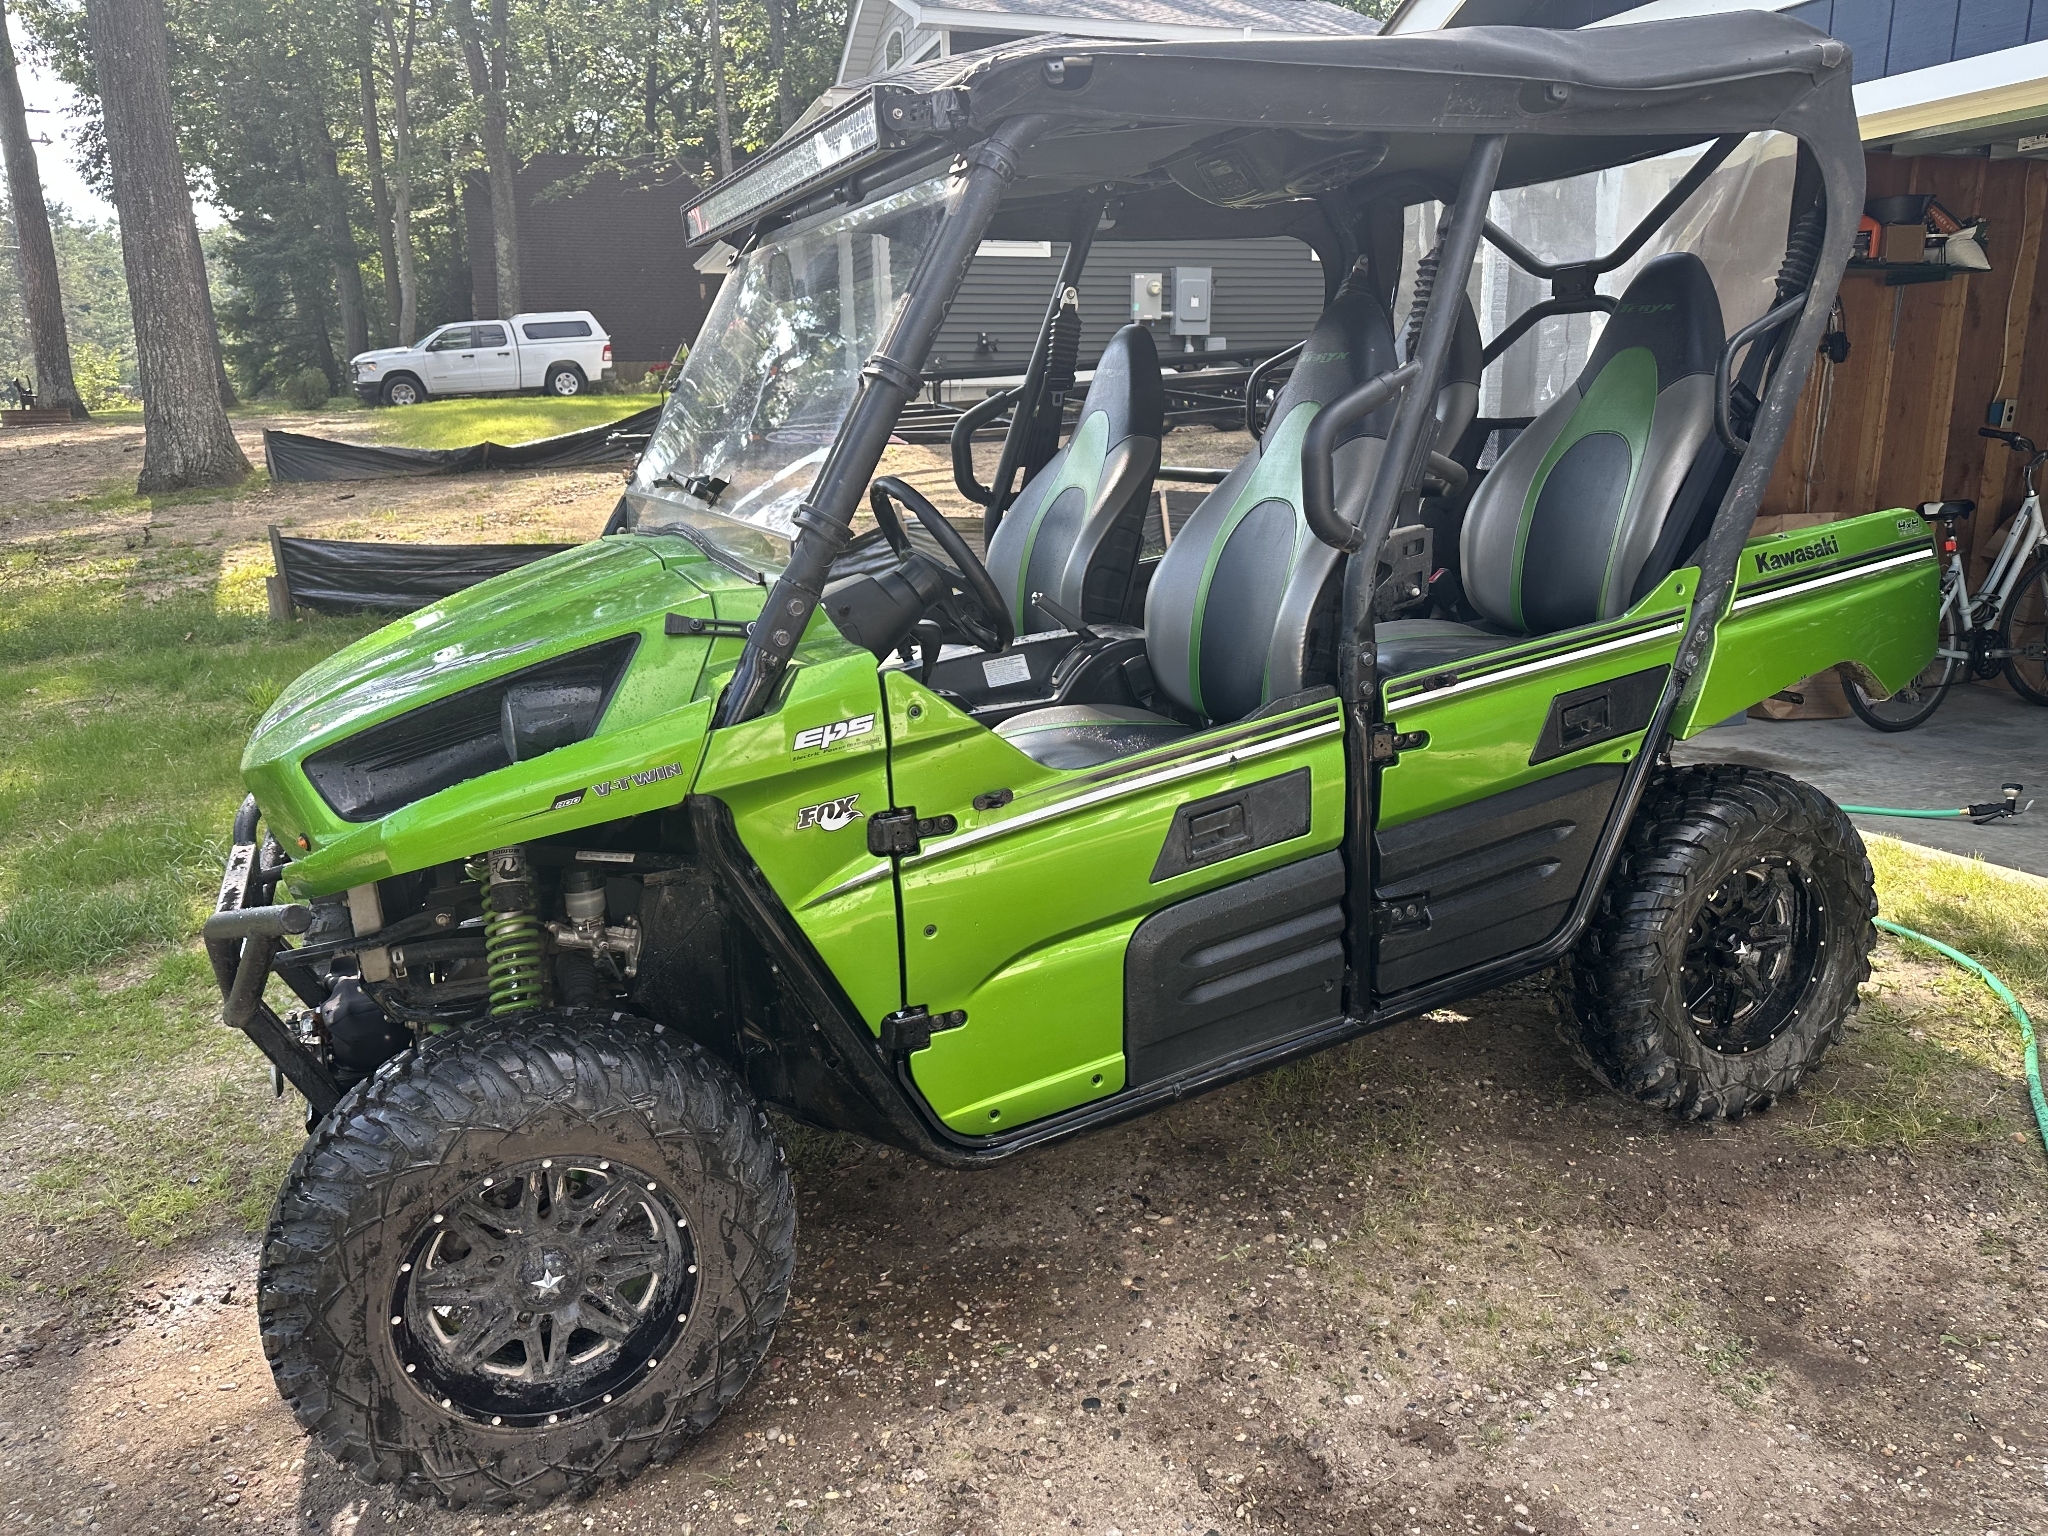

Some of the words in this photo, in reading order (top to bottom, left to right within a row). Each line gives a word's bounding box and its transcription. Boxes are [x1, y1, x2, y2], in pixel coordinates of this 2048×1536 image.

[1897, 516, 1919, 530] 4x4
[1754, 534, 1839, 574] Kawasaki
[792, 712, 876, 751] EPS
[591, 762, 683, 797] V-TWIN
[797, 793, 864, 832] FOX
